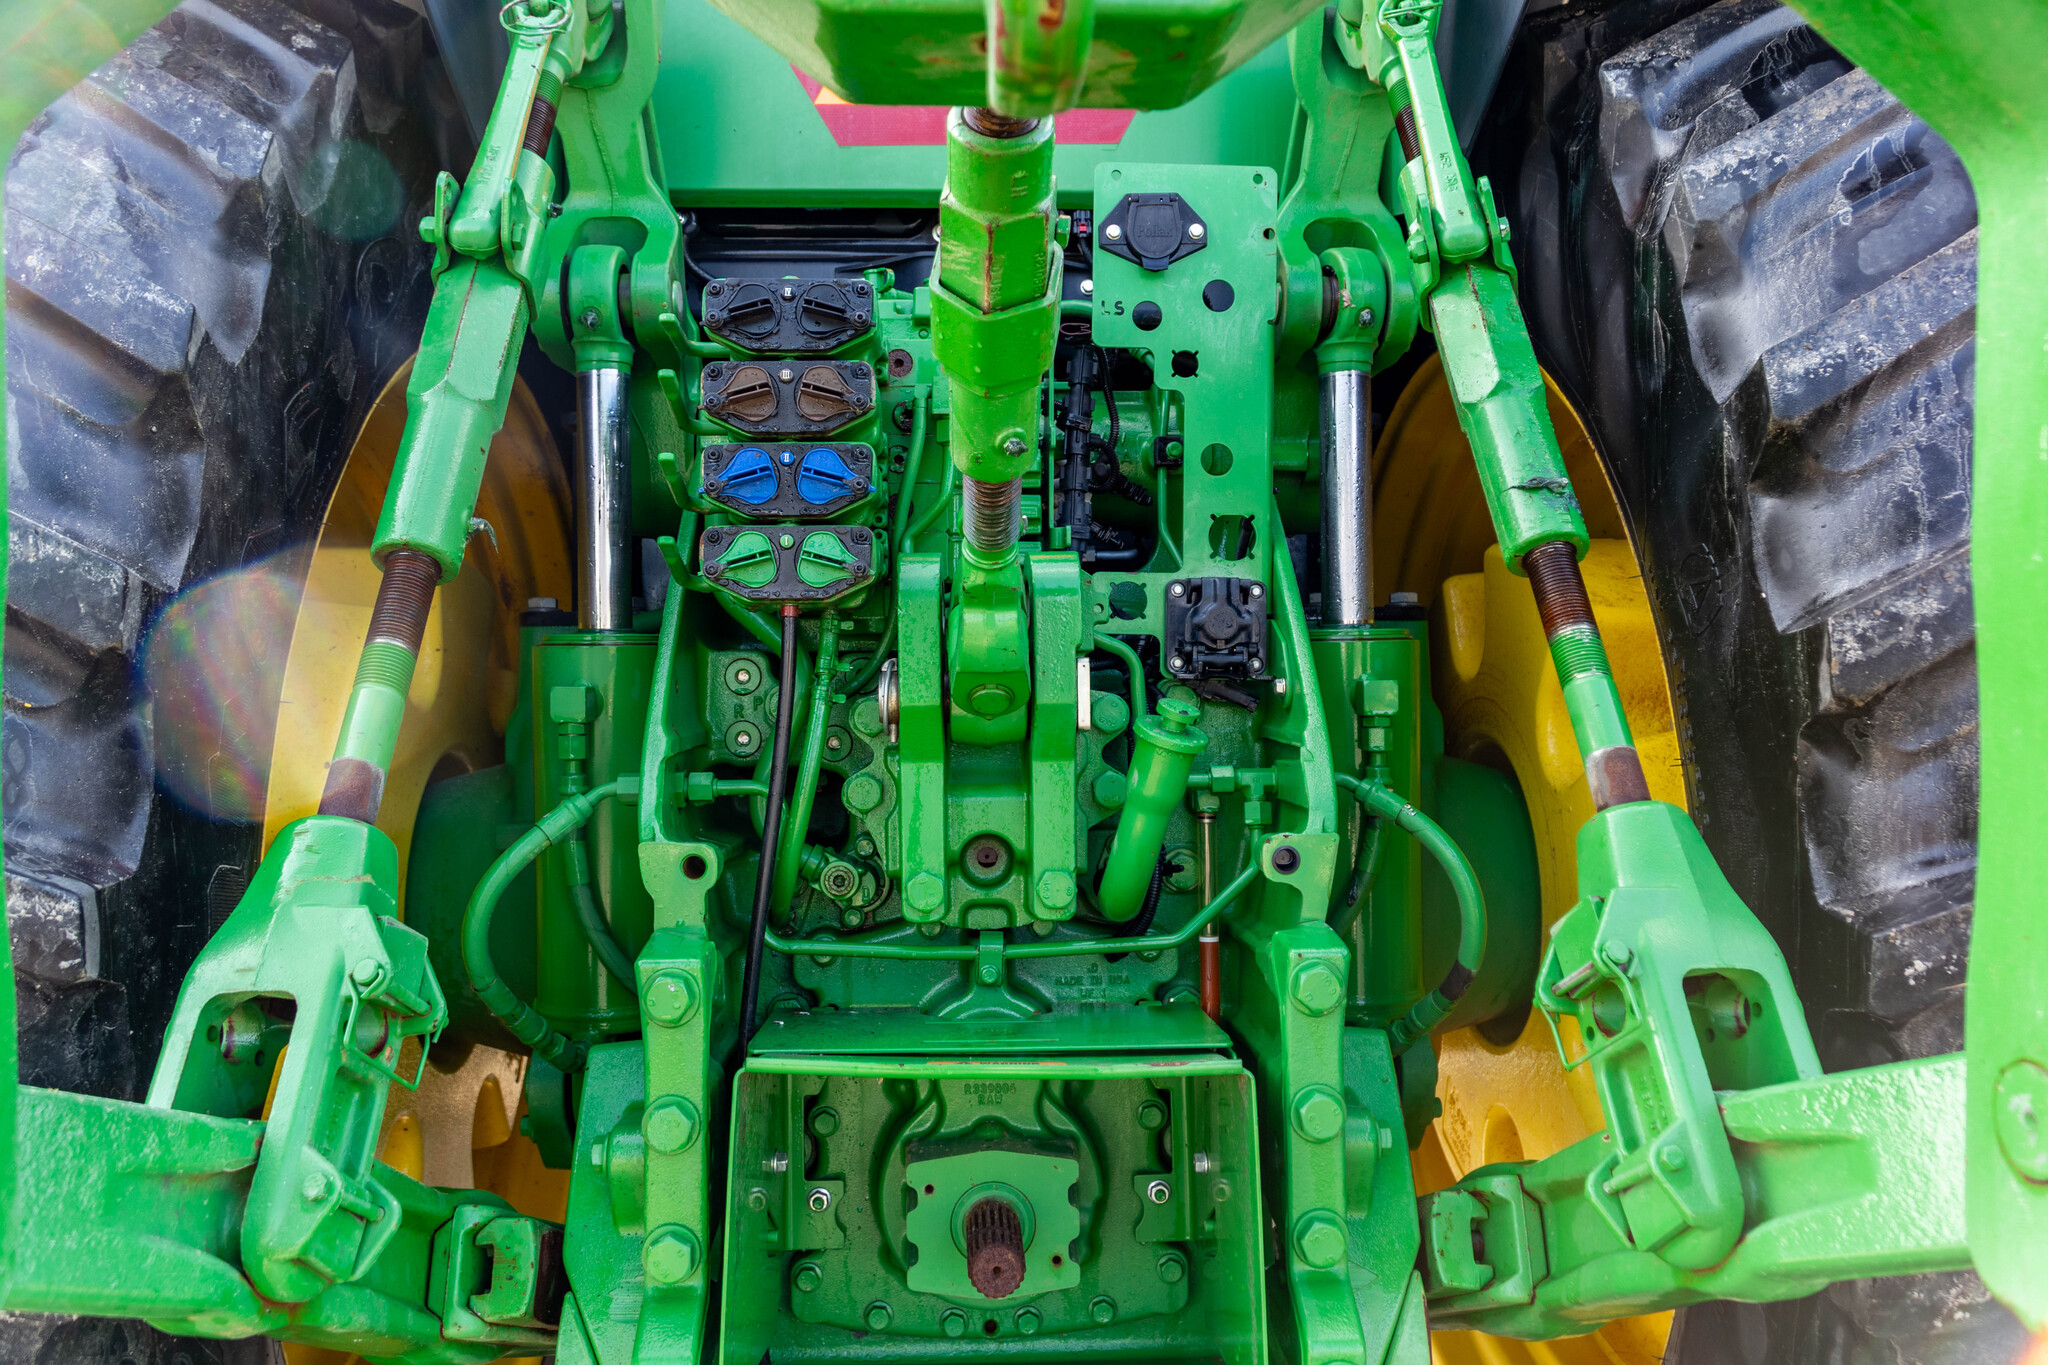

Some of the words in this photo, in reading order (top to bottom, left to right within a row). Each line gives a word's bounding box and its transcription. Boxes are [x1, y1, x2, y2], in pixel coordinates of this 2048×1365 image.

[1137, 223, 1174, 238] Pollak
[734, 703, 745, 719] R
[753, 696, 764, 712] P
[1055, 975, 1084, 986] MADE
[1090, 974, 1103, 986] IN
[1108, 973, 1131, 985] USA
[977, 1093, 1004, 1105] RAW
